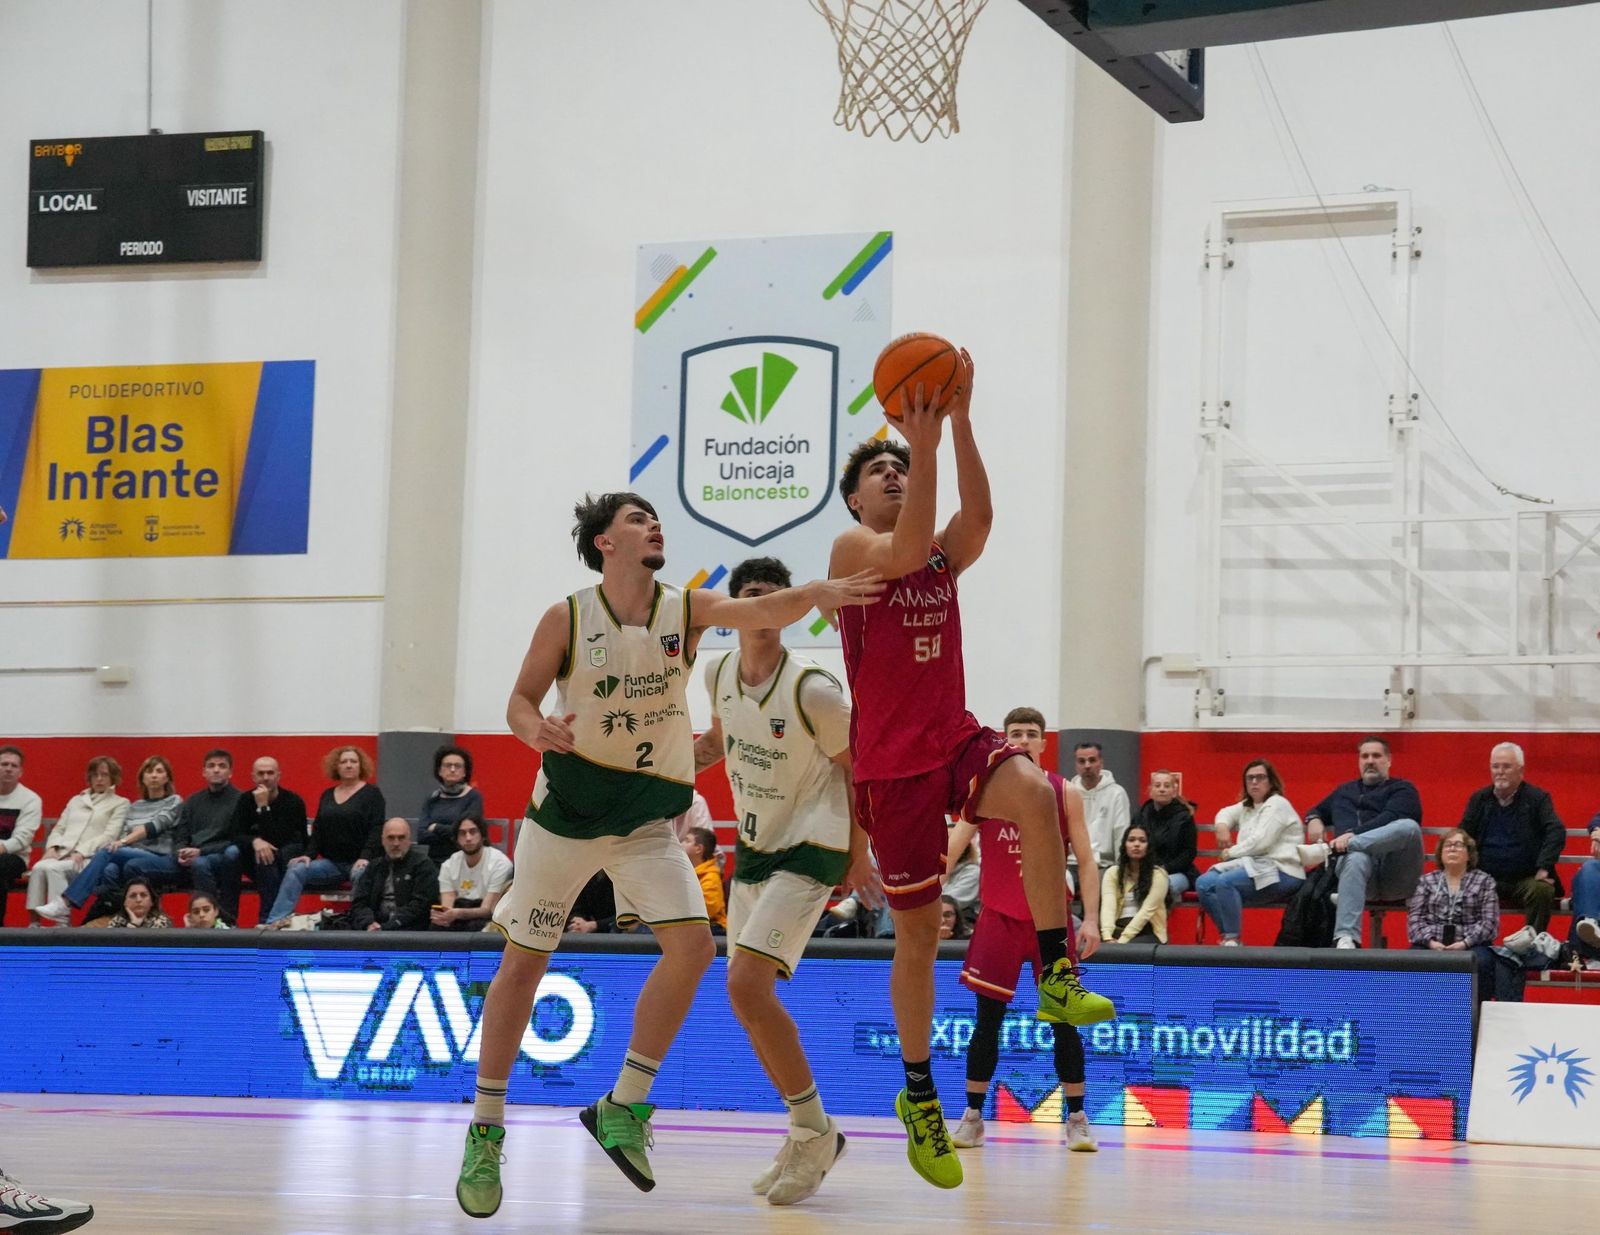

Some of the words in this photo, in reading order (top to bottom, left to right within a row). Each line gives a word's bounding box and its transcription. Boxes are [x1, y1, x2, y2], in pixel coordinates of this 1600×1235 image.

[39, 194, 98, 212] LOCAL
[187, 188, 248, 206] VISITANTE
[120, 241, 164, 256] PERIODO
[70, 381, 205, 399] POLIDEPORTIVO
[86, 414, 184, 454] Blas
[704, 433, 810, 456] Fundación
[48, 459, 219, 501] Infante
[719, 460, 795, 484] Unicaja
[702, 484, 810, 501] Baloncesto
[635, 741, 654, 769] 2
[1091, 1021, 1140, 1051] en
[1152, 1019, 1351, 1060] movilidad
